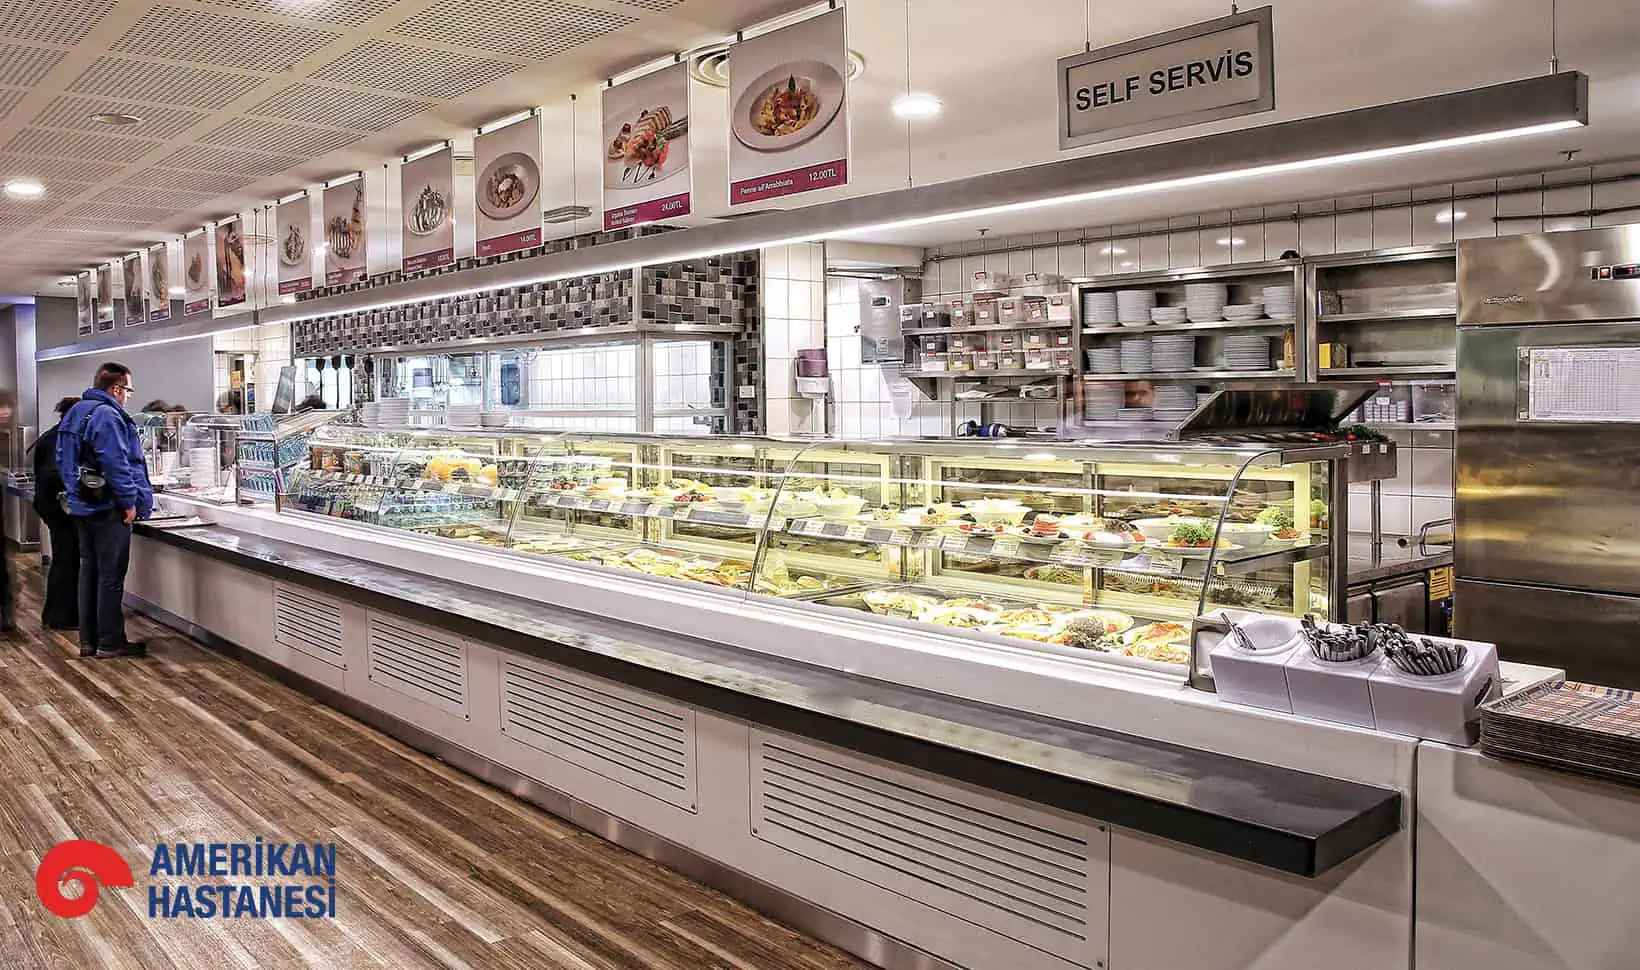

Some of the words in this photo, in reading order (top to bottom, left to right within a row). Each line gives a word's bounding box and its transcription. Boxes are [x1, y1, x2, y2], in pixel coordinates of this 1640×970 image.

[1076, 76, 1140, 110] SELF
[1149, 50, 1253, 95] SERVİS
[808, 168, 837, 182] 12.00TL
